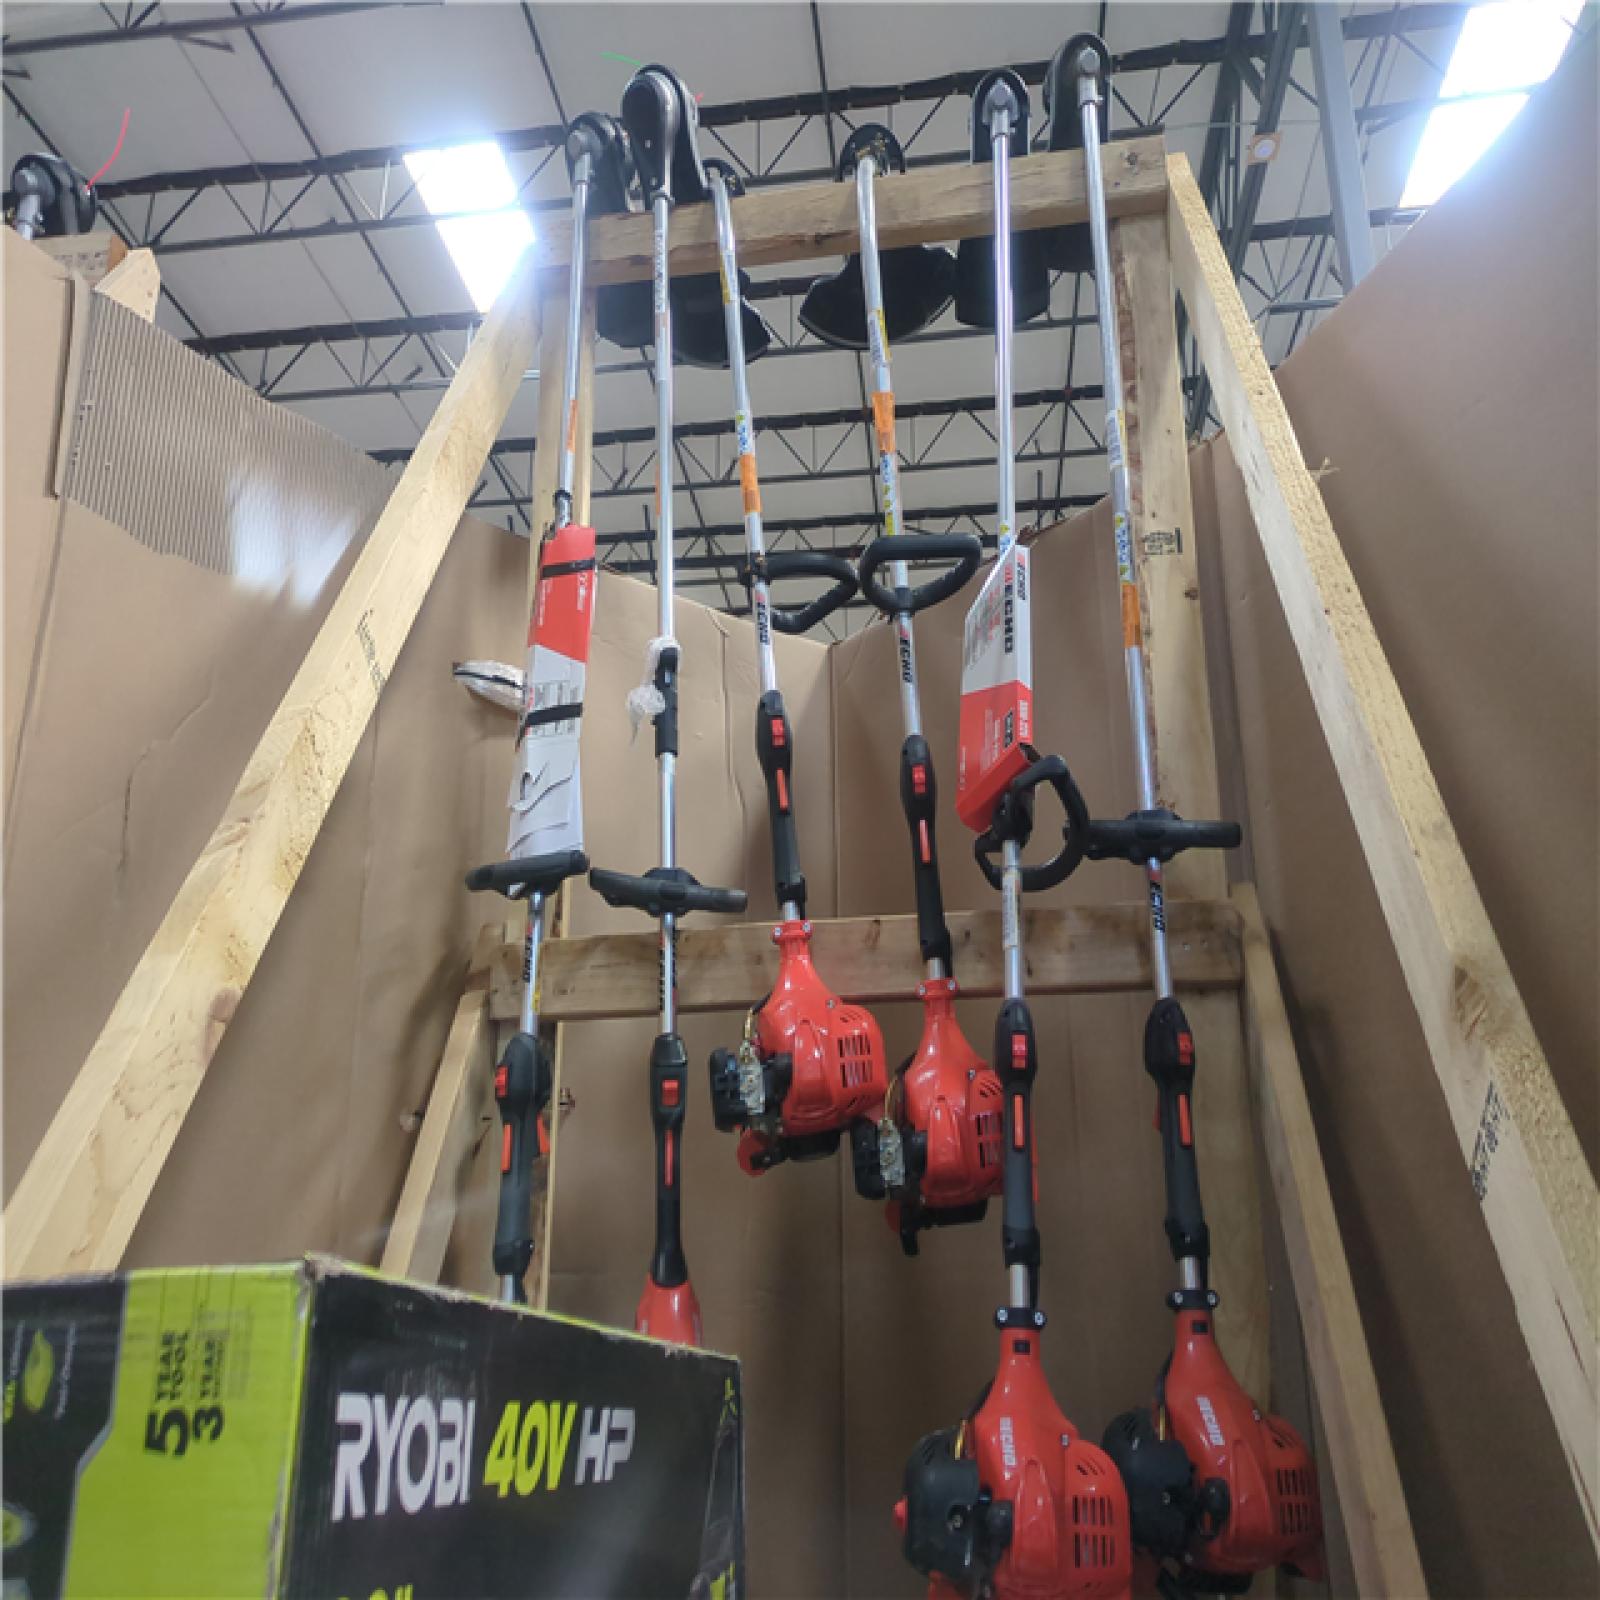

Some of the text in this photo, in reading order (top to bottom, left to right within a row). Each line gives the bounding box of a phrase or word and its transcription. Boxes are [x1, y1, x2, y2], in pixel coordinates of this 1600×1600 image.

[757, 602, 770, 645] ECHO
[1004, 584, 1014, 653] ECHO
[900, 638, 913, 684] ECHO
[1150, 880, 1166, 933] ECHO
[144, 1407, 190, 1457] 5
[193, 1405, 225, 1442] 3
[331, 1392, 637, 1522] RYOBI 40V HP
